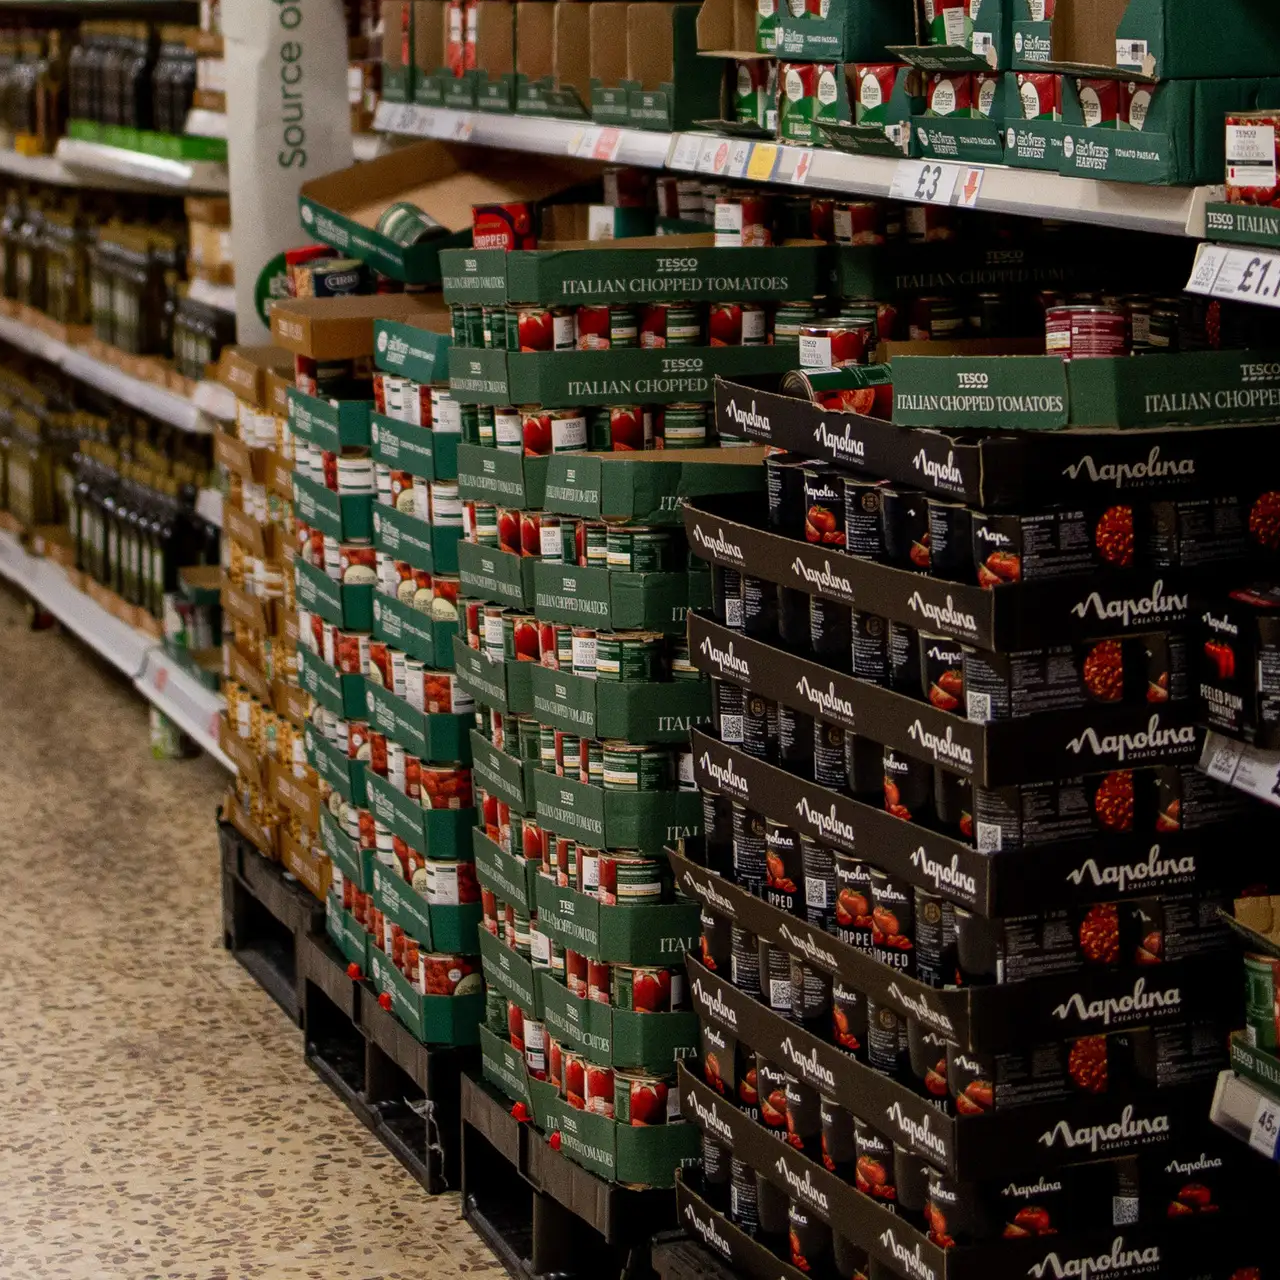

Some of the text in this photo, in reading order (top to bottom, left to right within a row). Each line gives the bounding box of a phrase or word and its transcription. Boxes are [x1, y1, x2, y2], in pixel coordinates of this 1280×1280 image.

[279, 41, 306, 169] Source
[960, 136, 996, 146] TOMATO PASSATA
[1017, 147, 1045, 159] HARVEST
[1076, 142, 1108, 158] GROWER'S
[1115, 148, 1160, 161] TOMATO PASSATA
[1076, 156, 1107, 170] HARVEST
[914, 165, 942, 200] £3
[1207, 211, 1234, 230] TESCO
[1237, 214, 1279, 235] ITALIAN
[656, 258, 698, 271] TESCO
[562, 276, 788, 294] ITALIAN CHOPPED TOMATOES
[662, 358, 703, 371] TESCO
[957, 373, 988, 385] TESCO
[1239, 363, 1280, 377] TESCO
[568, 378, 708, 397] ITALIAN CHOPPED
[897, 394, 1063, 412] ITALIAN CHOPPED TOMATOES
[1144, 393, 1212, 414] ITALIAN
[726, 399, 770, 431] Napolina
[813, 421, 864, 459] Napolina
[1062, 445, 1195, 489] Napolina
[693, 523, 744, 560] Napolina
[791, 557, 853, 595] Napolina
[908, 591, 977, 632] Napolina
[700, 636, 750, 675] Napolina
[796, 675, 854, 717] Napolina
[1200, 683, 1243, 711] PEELED PLUM
[908, 719, 973, 765] Napolina
[1066, 714, 1196, 761] Napolina
[1128, 749, 1158, 760] CREATO
[699, 751, 748, 792] Napolina
[796, 796, 854, 841] Napolina
[910, 846, 977, 895] Napolina
[1065, 844, 1196, 892] Napolina
[1128, 880, 1157, 890] CREATO
[779, 923, 838, 967] Napolina
[887, 981, 953, 1031] Napolina
[1052, 977, 1182, 1025] Napolina
[780, 1037, 835, 1087] Napolina
[1232, 1045, 1254, 1068] TESCO
[886, 1101, 946, 1157] Napolina
[1038, 1104, 1169, 1152] Napolina
[1257, 1110, 1277, 1137] 45p
[1164, 1153, 1223, 1175] Napolina
[776, 1156, 829, 1209] Napolina
[1001, 1176, 1062, 1199] Napolina
[879, 1228, 935, 1280] Napolina
[1027, 1236, 1160, 1280] Napolina
